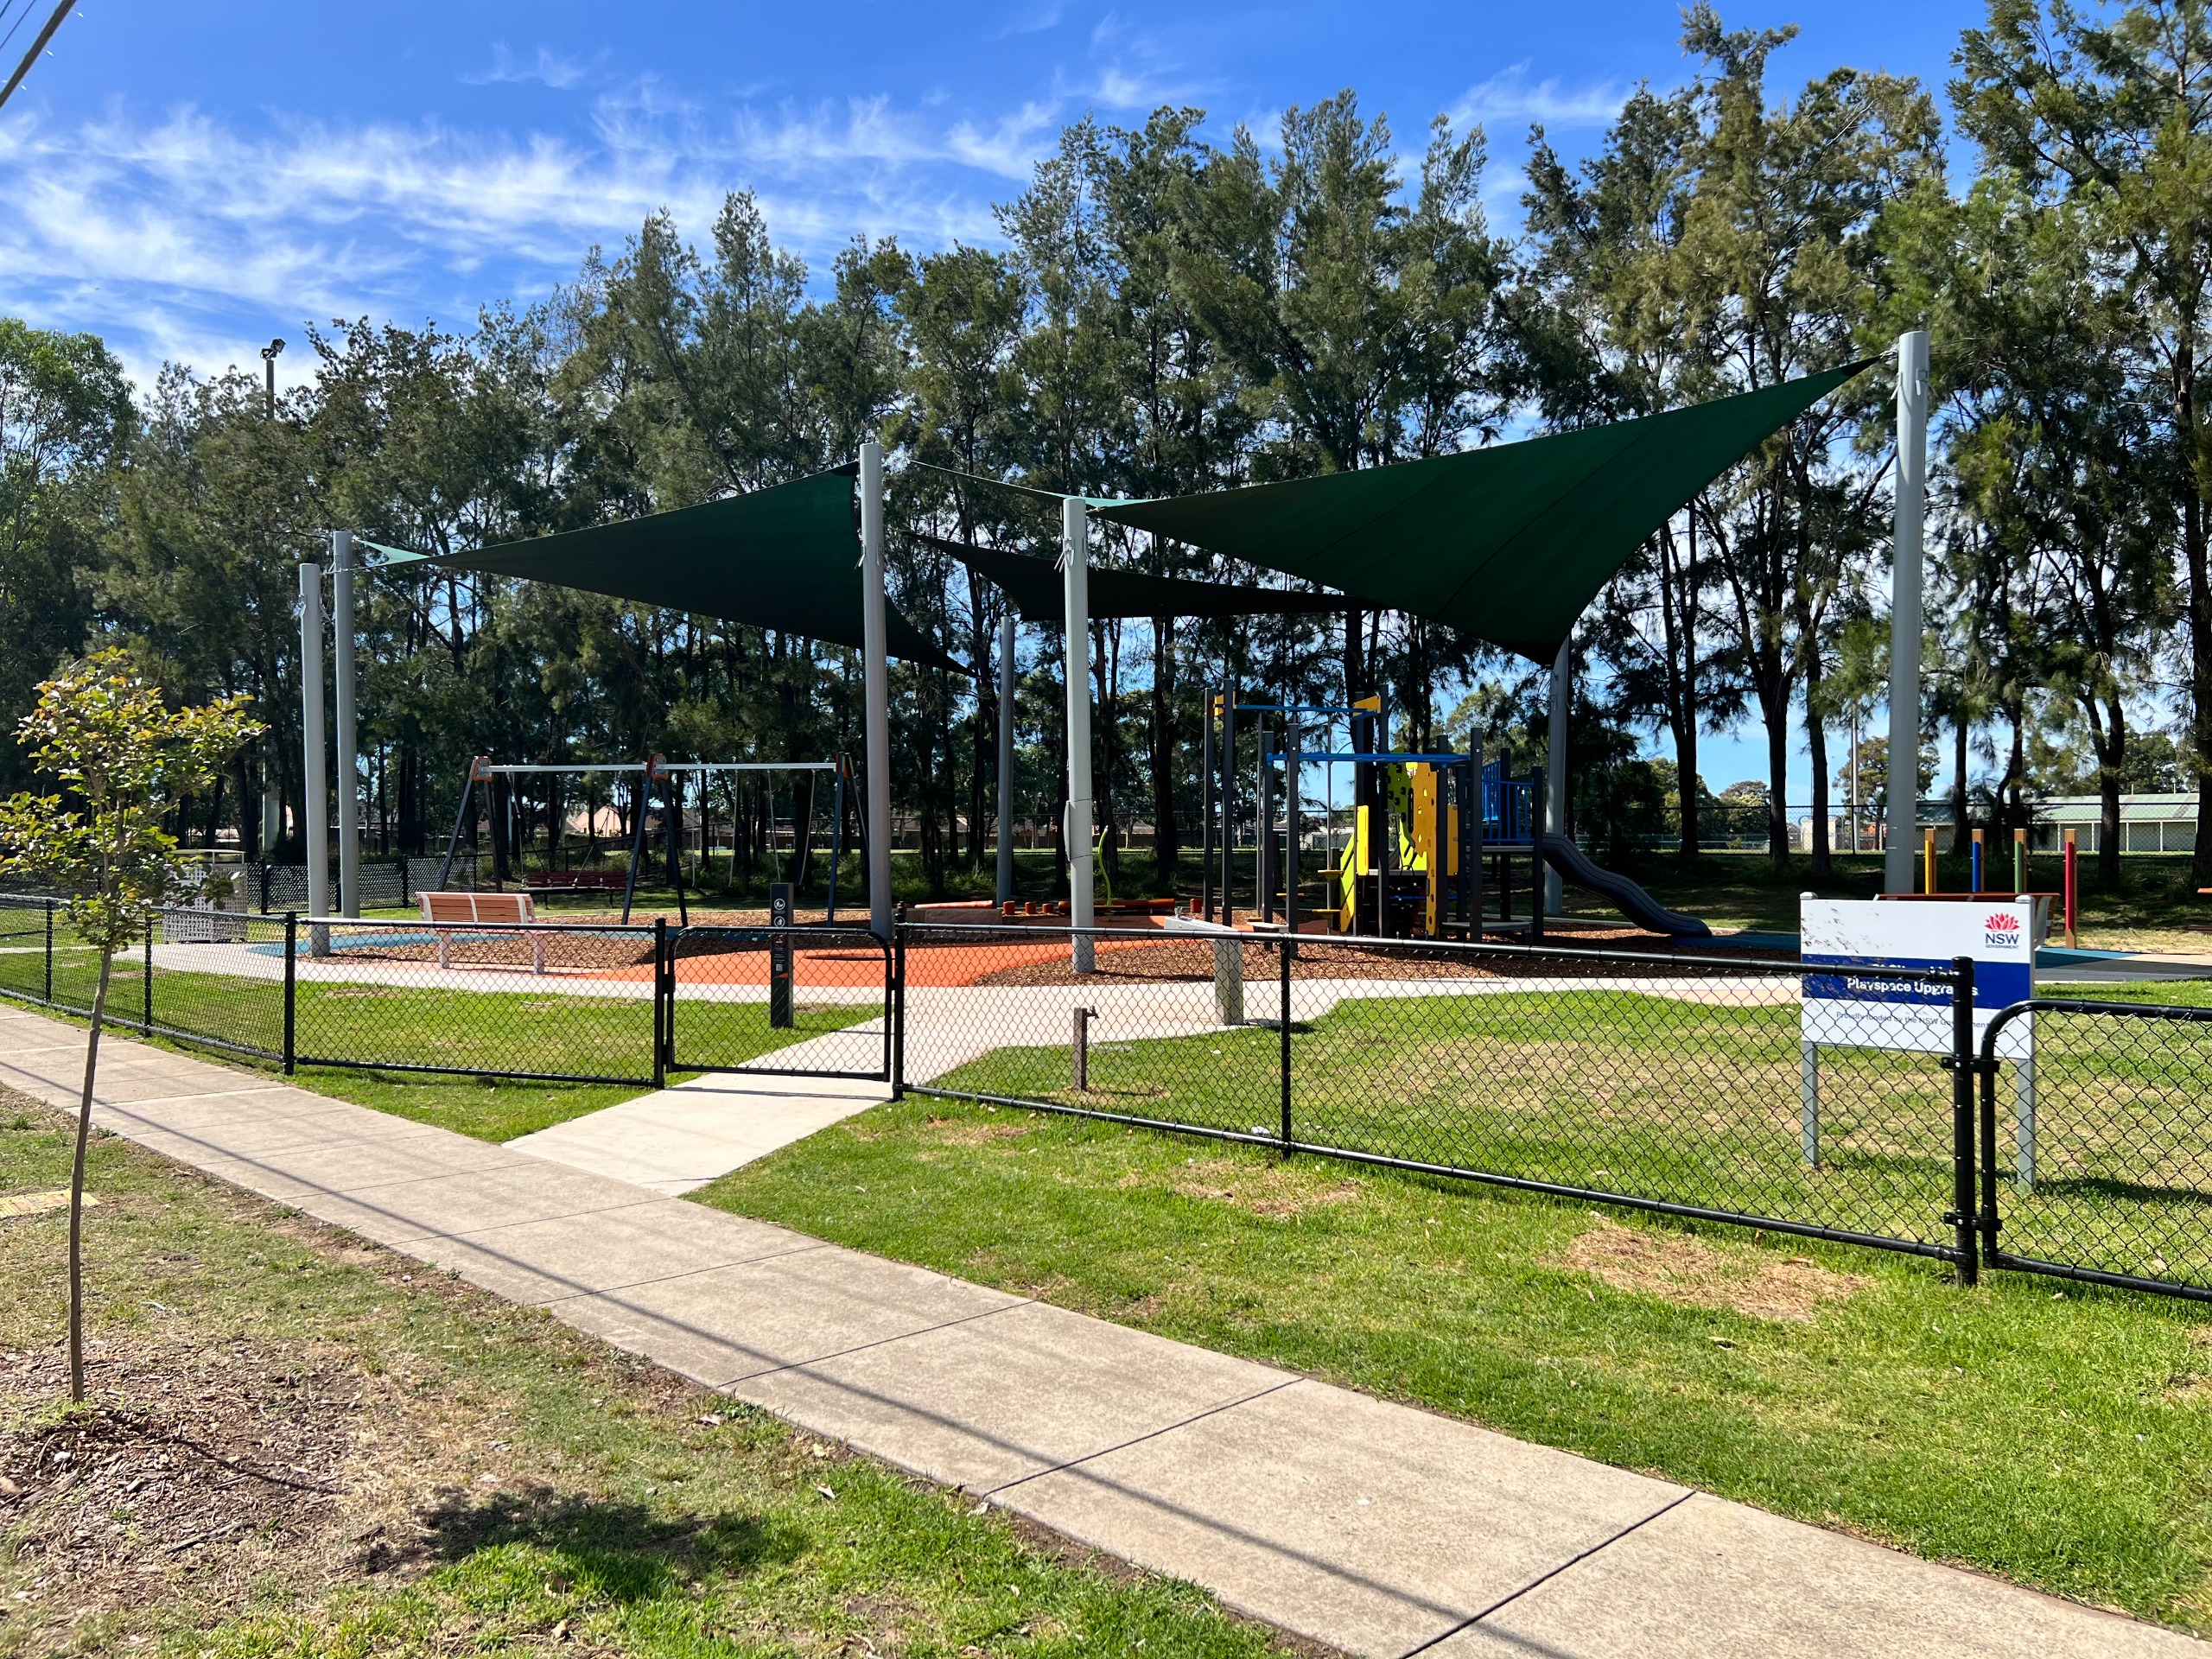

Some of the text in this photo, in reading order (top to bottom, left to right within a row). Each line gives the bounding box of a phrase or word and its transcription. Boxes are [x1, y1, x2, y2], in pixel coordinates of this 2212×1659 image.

[1985, 932, 2019, 944] NSW
[1847, 977, 1979, 996] Playspace Upgras
[1835, 1011, 1864, 1021] Proudly
[1866, 1014, 1891, 1022] funded
[1904, 1015, 1917, 1024] the
[1918, 1016, 1939, 1026] NSW
